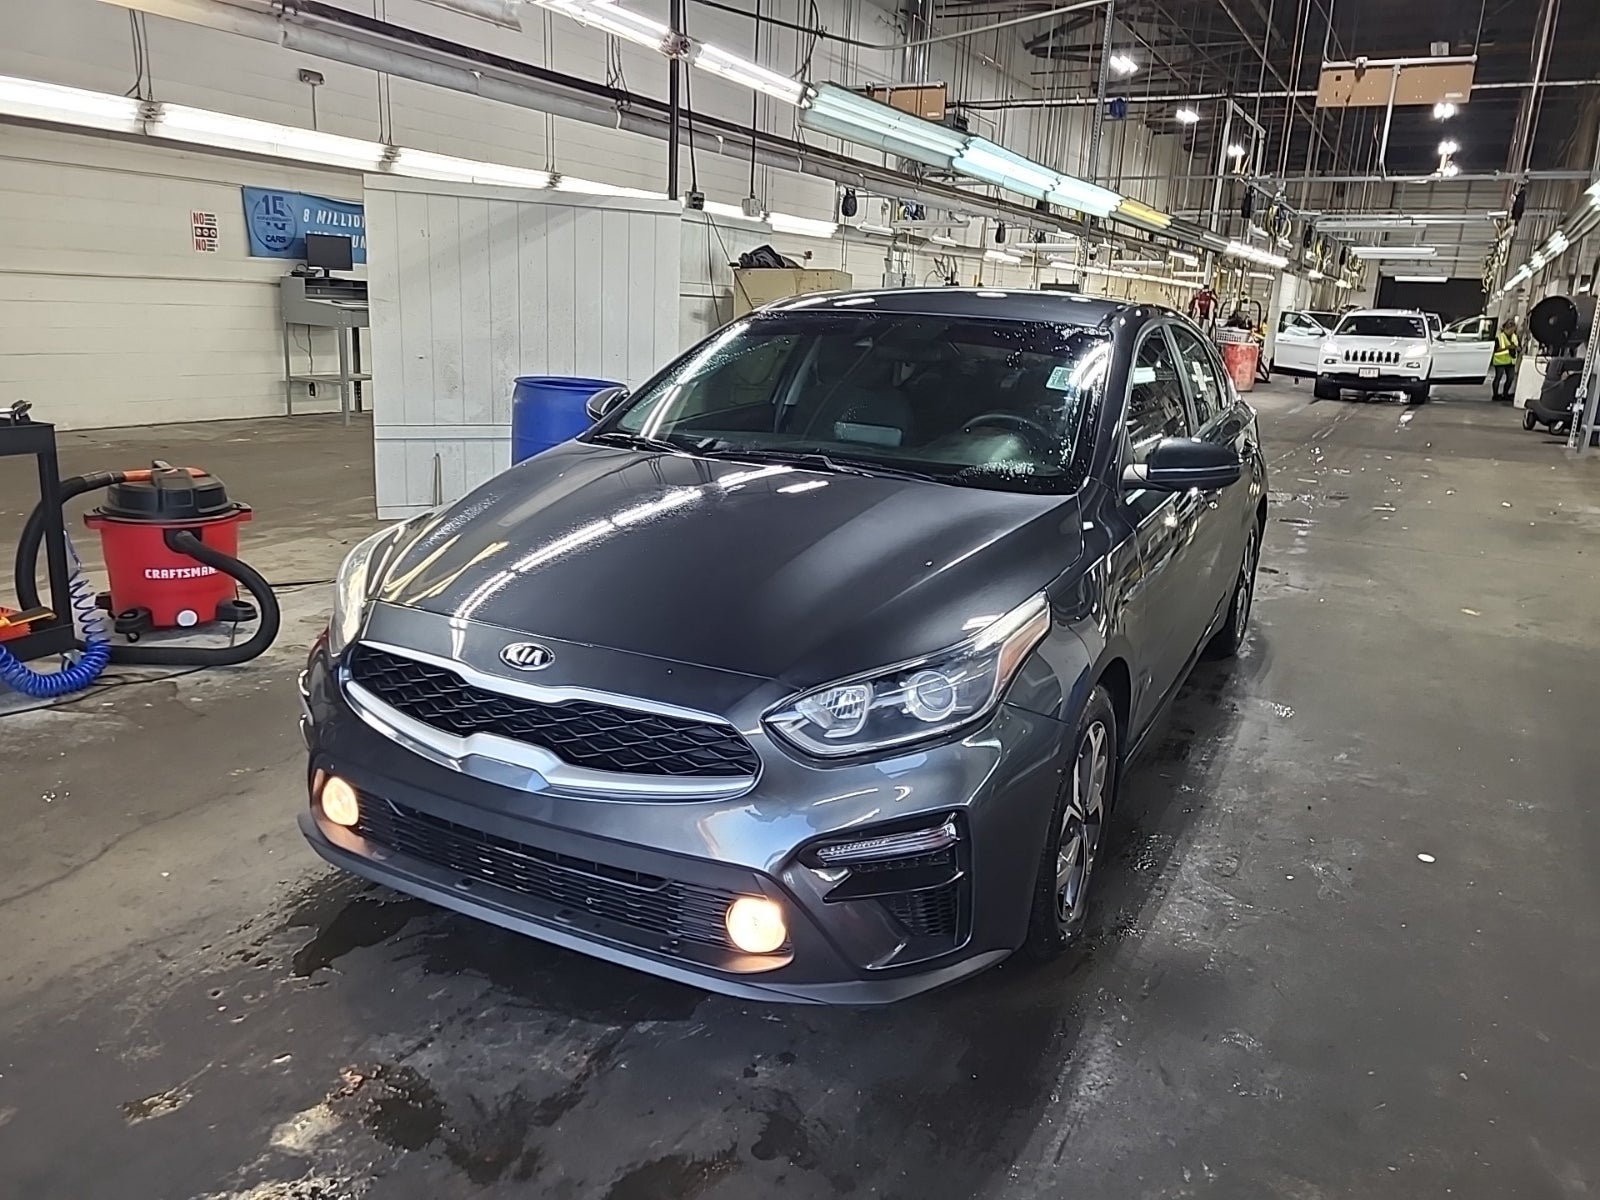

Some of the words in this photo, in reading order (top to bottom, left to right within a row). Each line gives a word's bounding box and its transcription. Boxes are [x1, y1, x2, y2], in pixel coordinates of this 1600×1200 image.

[193, 212, 204, 225] NO
[303, 208, 310, 223] 8
[195, 238, 206, 251] NO
[265, 234, 286, 243] CARS
[505, 645, 544, 666] KIA
